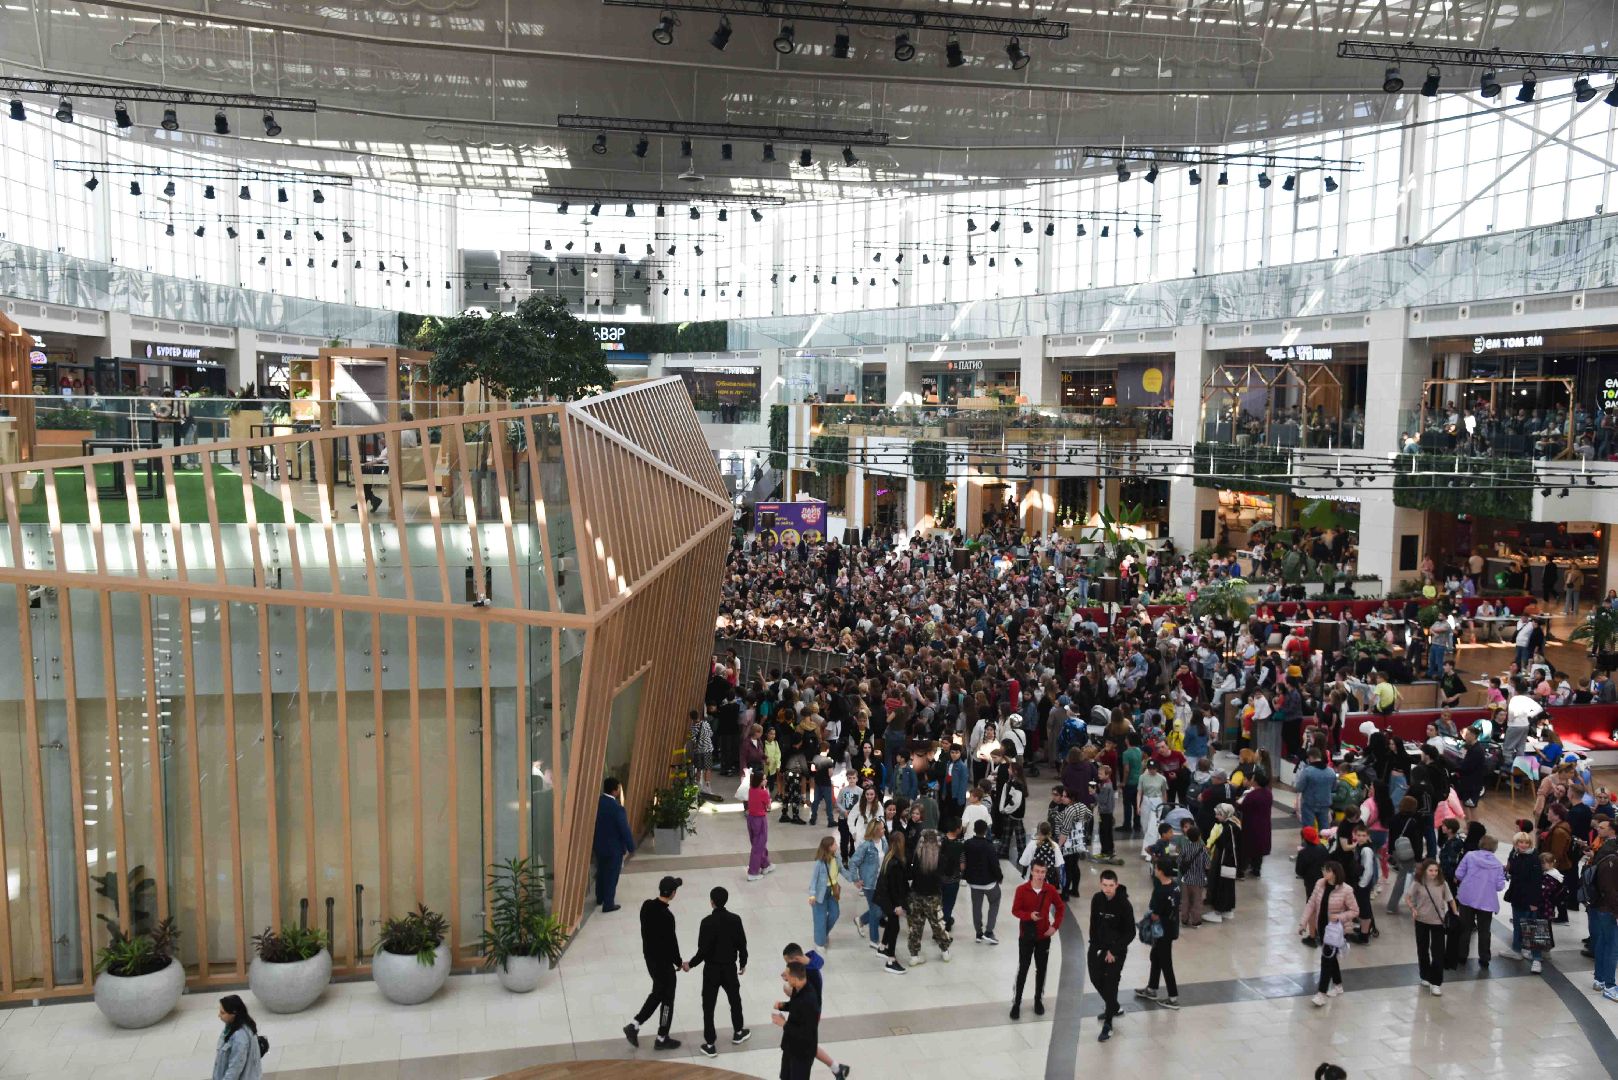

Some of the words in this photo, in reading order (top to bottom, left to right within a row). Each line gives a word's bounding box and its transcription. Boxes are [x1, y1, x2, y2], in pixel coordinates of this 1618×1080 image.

[156, 345, 181, 357] БУРГЕР
[182, 347, 201, 359] КИНГ
[958, 360, 983, 370] ПАТИО
